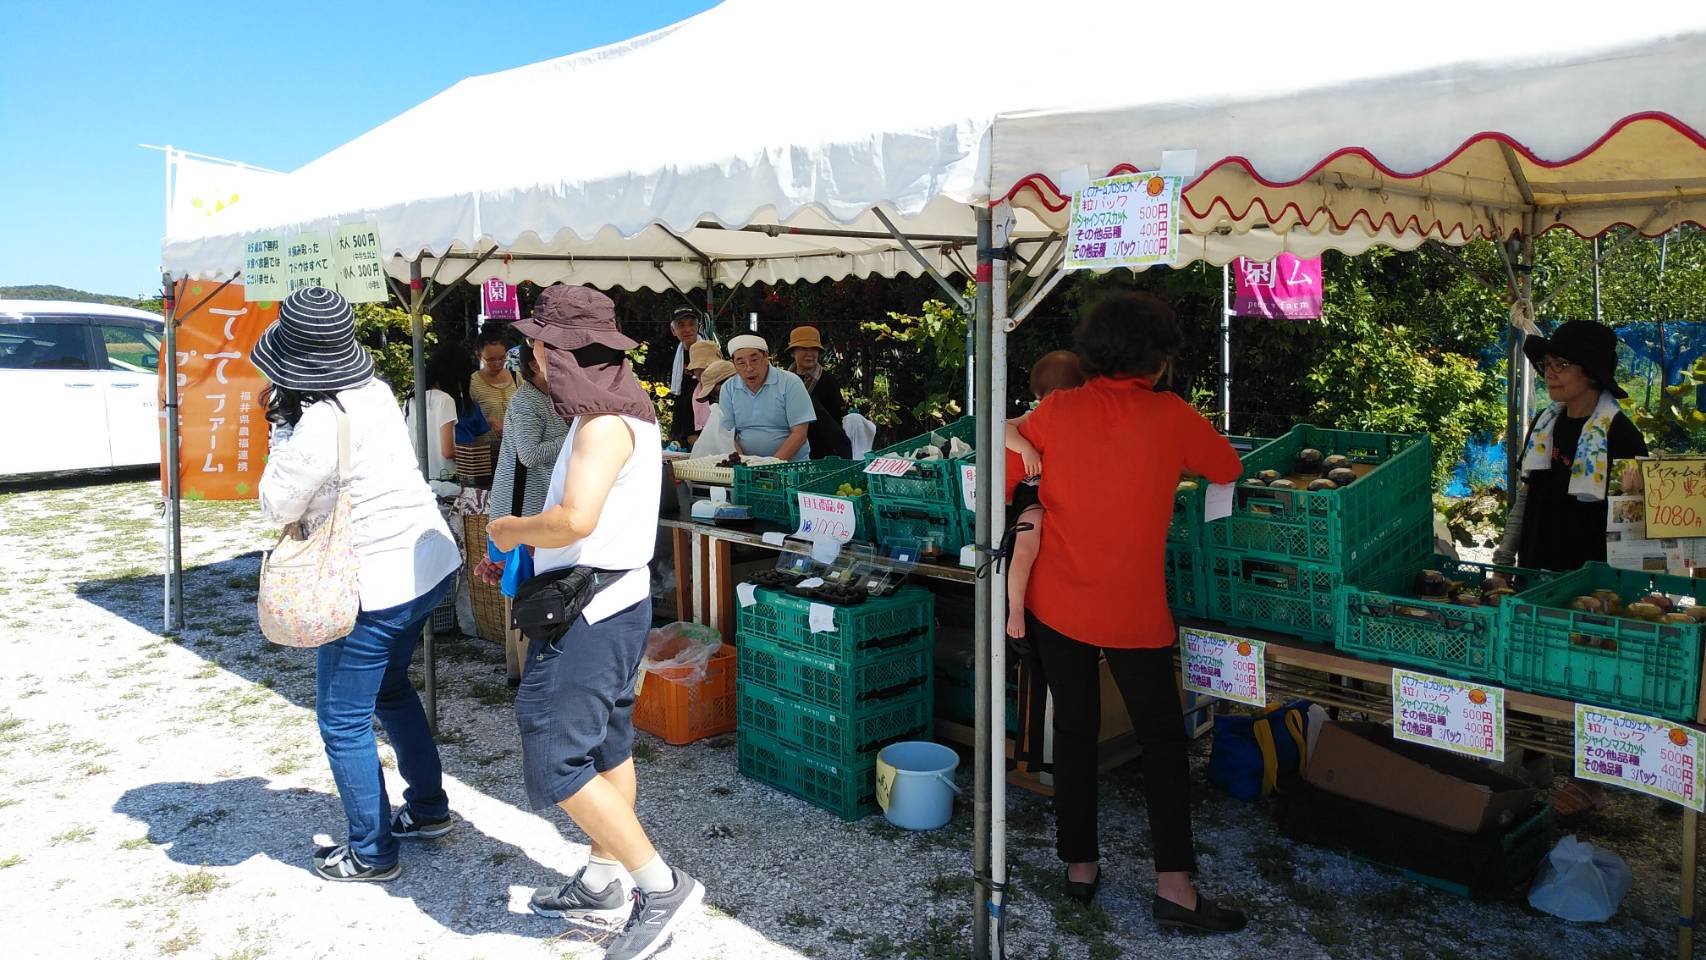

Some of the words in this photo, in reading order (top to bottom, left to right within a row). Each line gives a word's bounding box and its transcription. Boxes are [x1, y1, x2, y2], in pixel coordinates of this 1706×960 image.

[352, 233, 375, 248] 500円
[358, 262, 379, 277] 300円
[203, 307, 248, 473] ててファーム
[1652, 505, 1702, 528] 1080円
